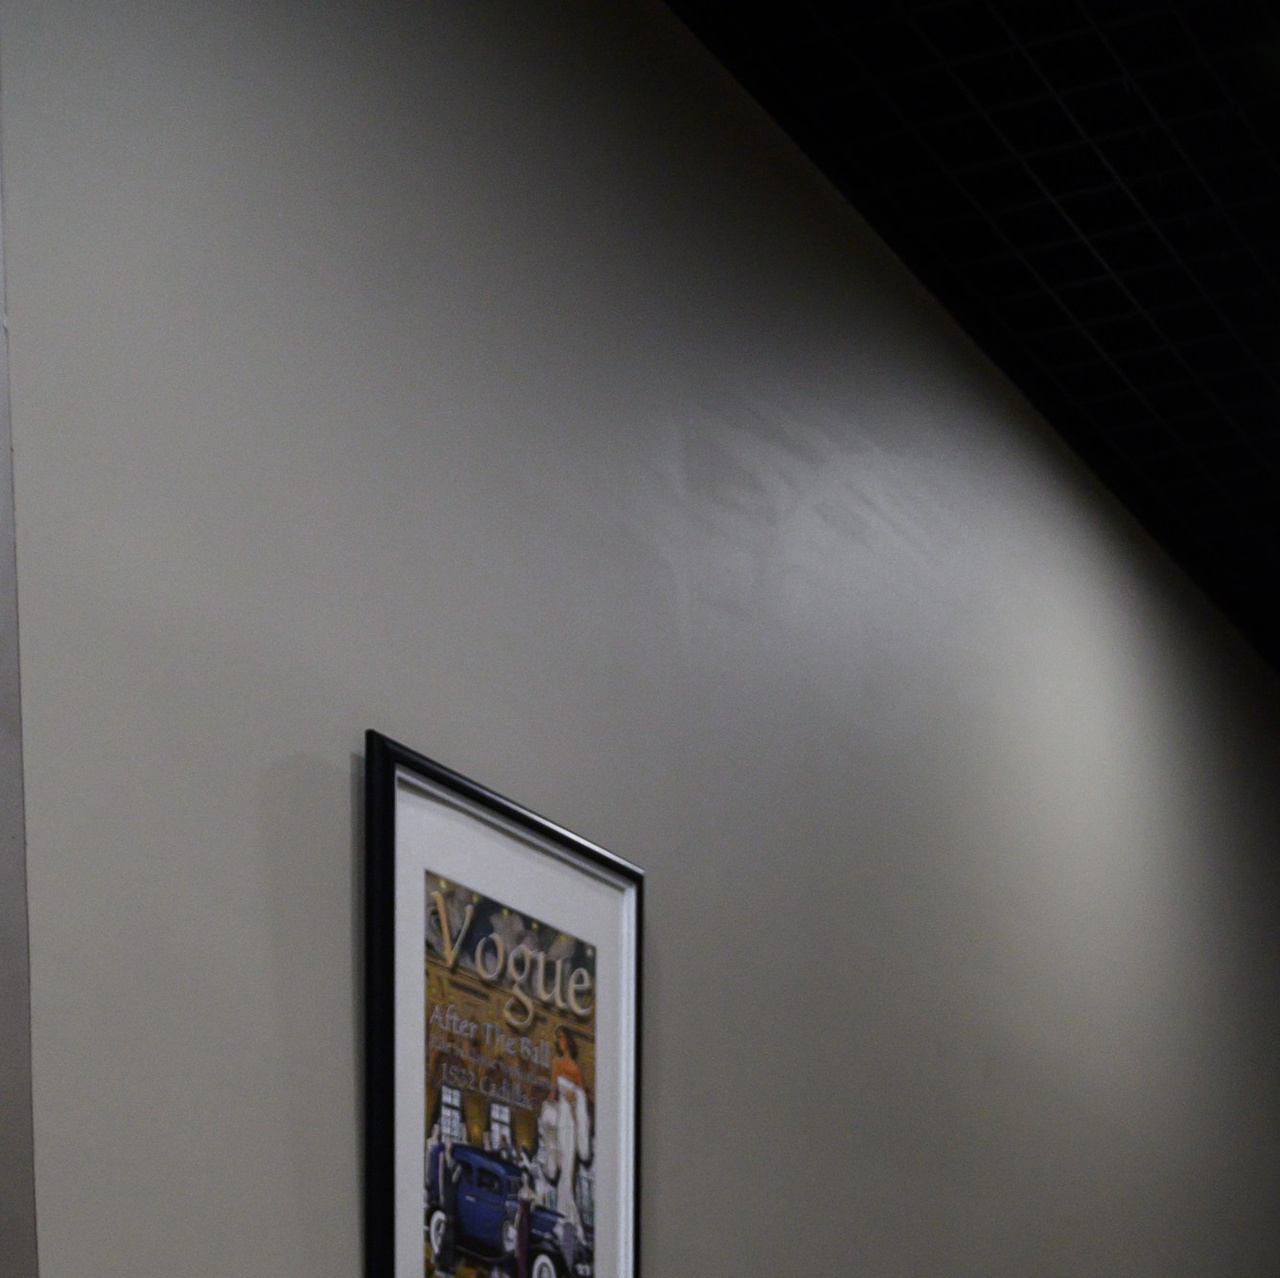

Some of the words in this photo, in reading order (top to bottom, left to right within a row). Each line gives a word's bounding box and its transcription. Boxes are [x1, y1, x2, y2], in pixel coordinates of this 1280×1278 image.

[430, 890, 592, 1028] Vogue
[429, 1003, 479, 1039] After
[483, 1022, 518, 1056] The
[520, 1036, 551, 1069] Ball
